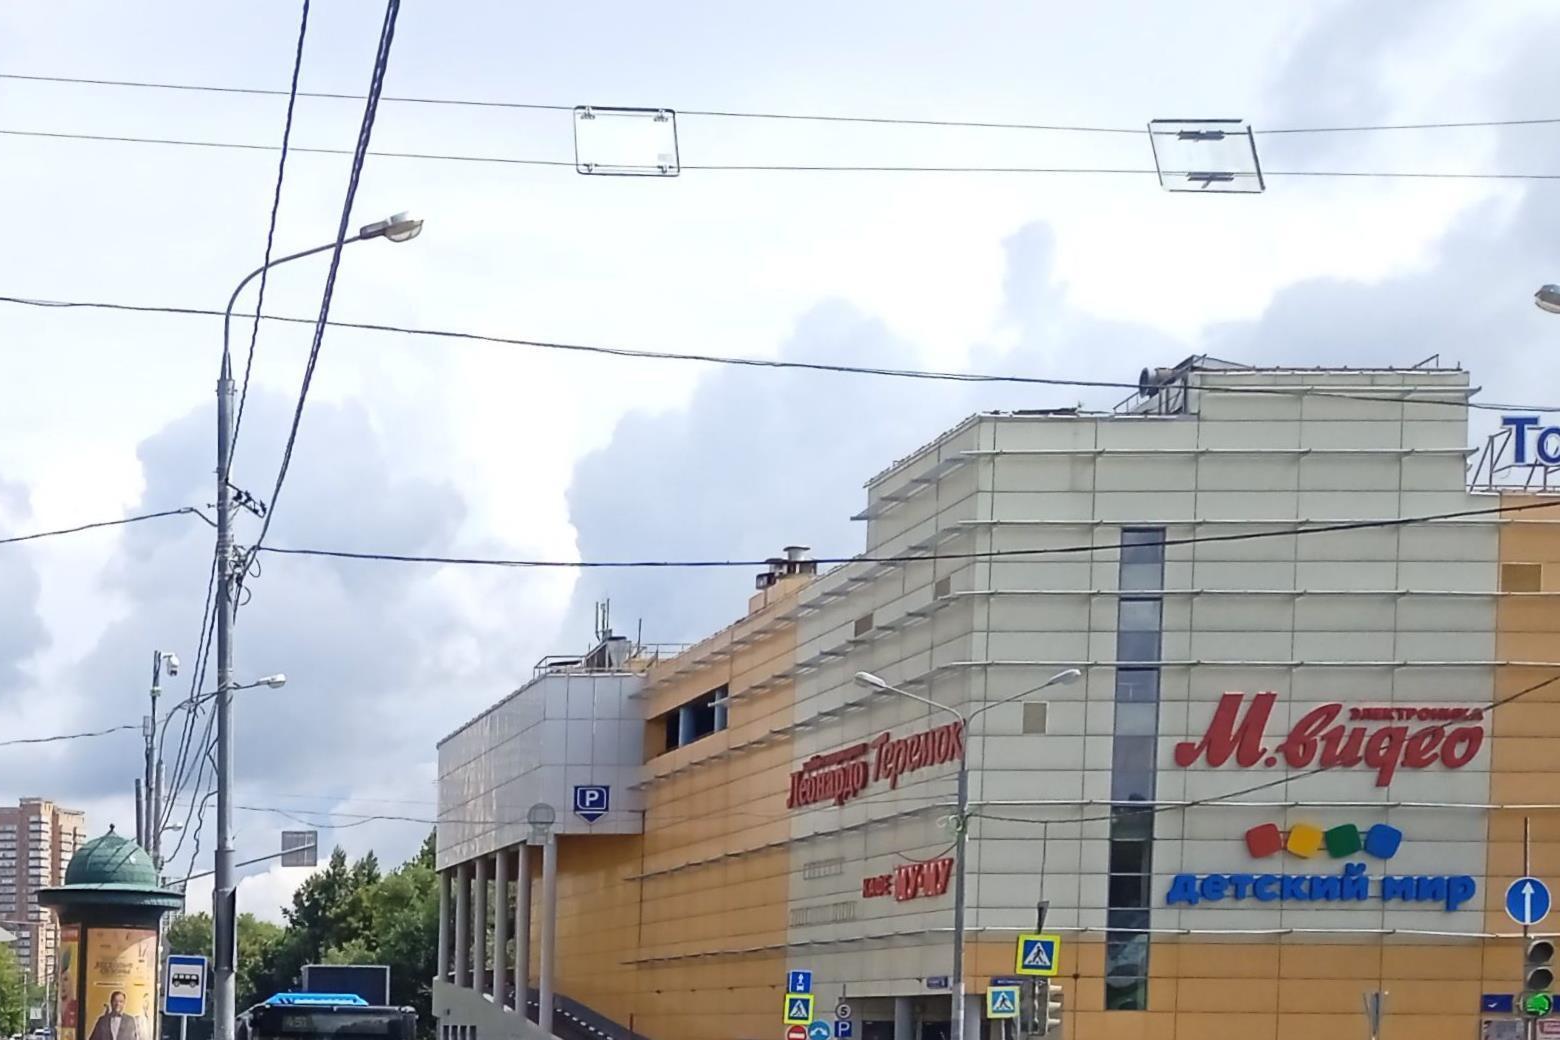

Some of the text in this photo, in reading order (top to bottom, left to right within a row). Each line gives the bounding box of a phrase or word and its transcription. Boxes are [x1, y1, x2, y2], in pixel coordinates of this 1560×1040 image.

[871, 721, 963, 789] Теремок
[1174, 692, 1484, 787] М.видео
[787, 761, 870, 809] Леонардо
[1167, 863, 1476, 911] детский мир
